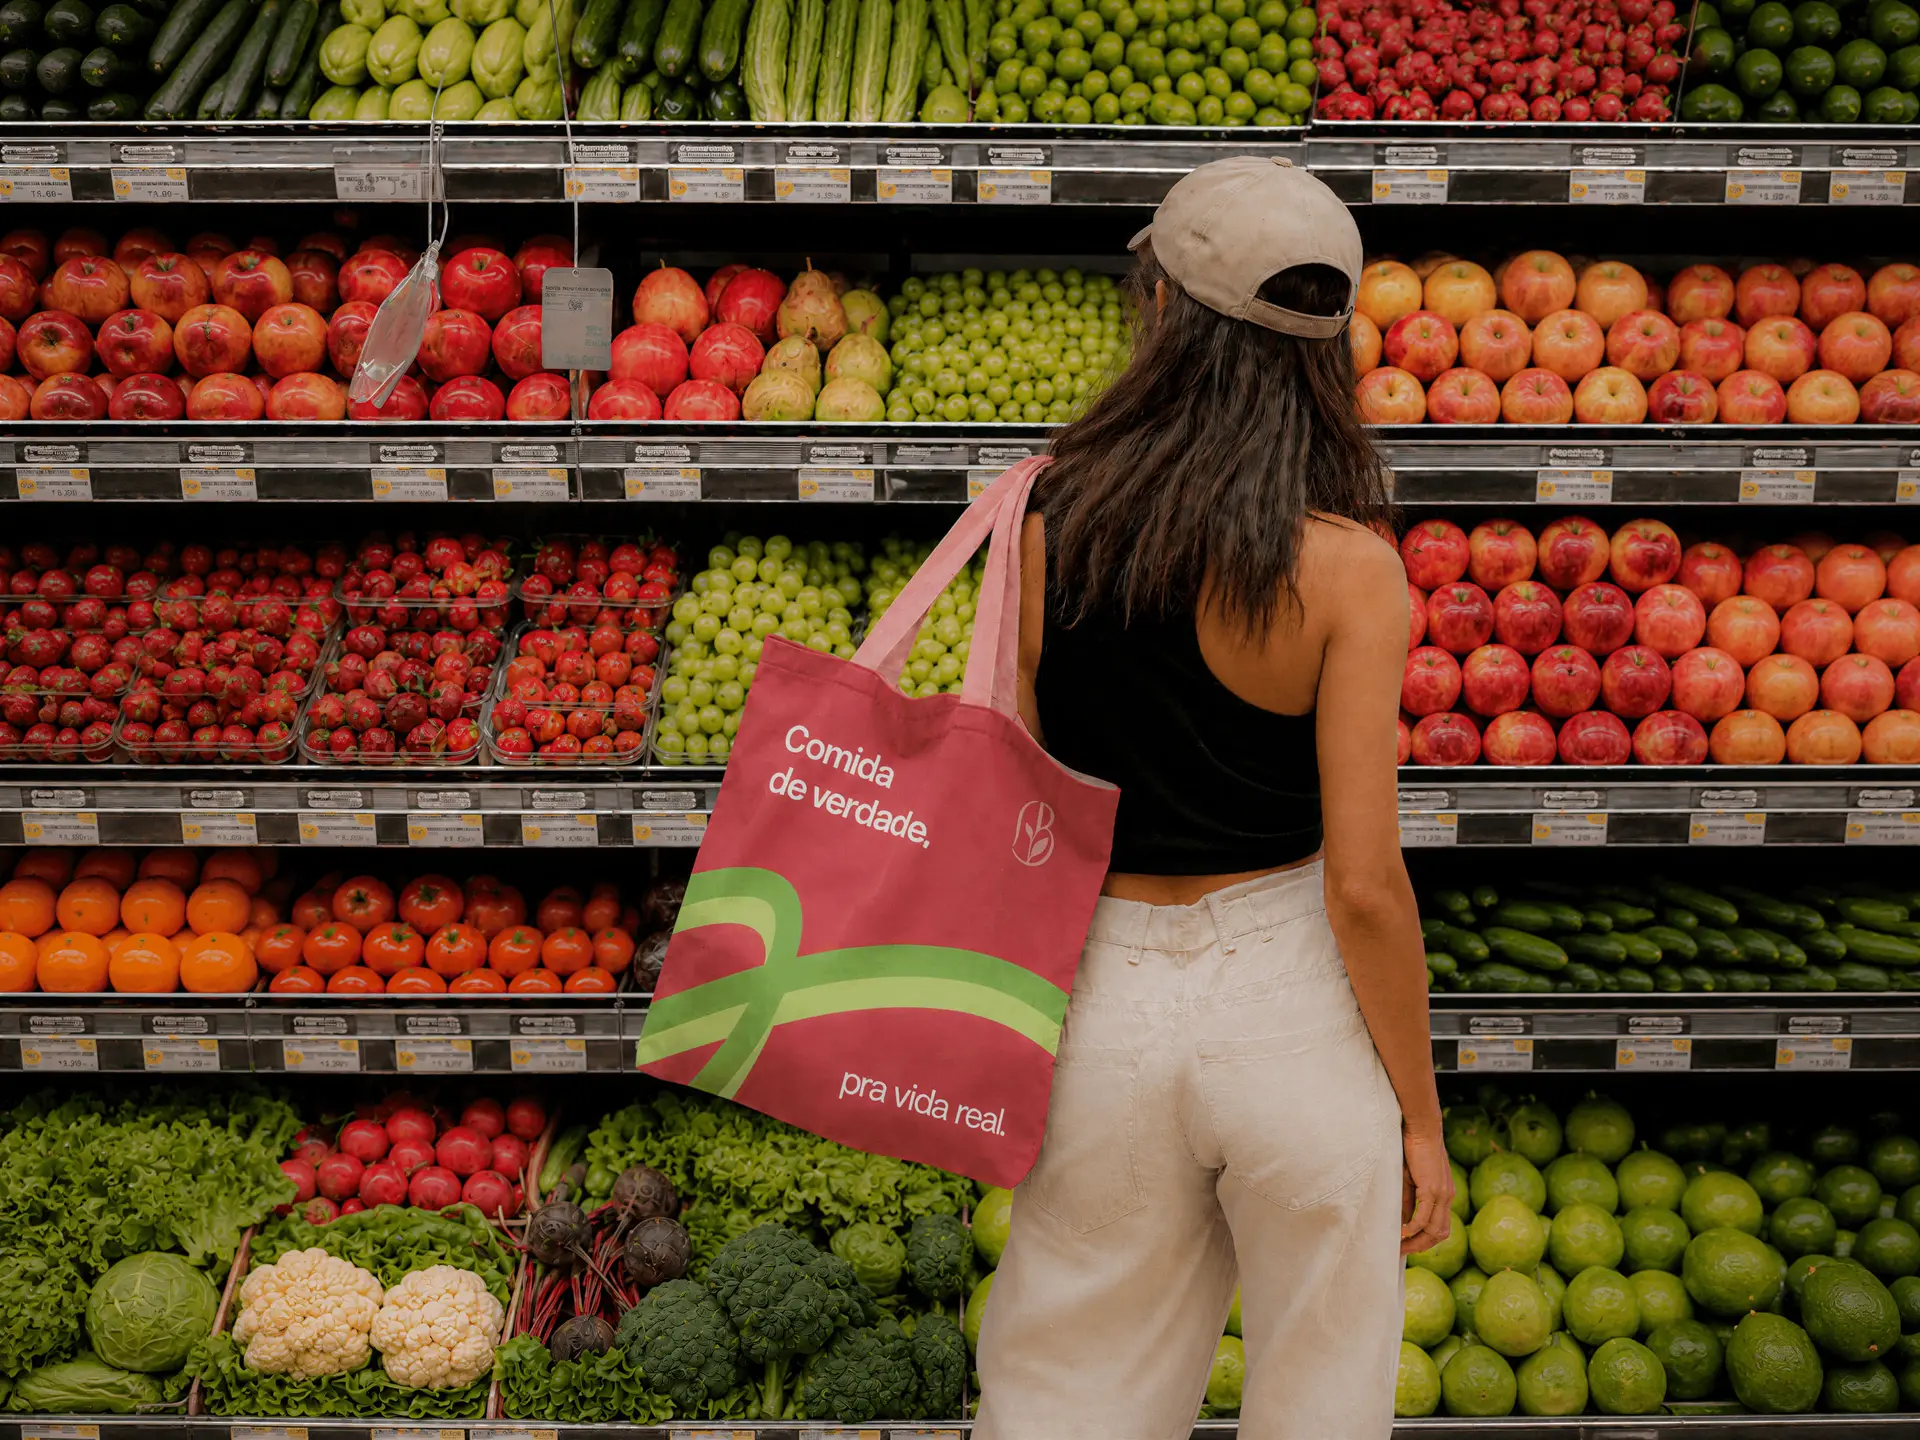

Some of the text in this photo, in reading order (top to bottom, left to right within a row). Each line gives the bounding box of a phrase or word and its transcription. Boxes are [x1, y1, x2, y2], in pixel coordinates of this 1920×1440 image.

[785, 725, 895, 789] Comida
[769, 767, 930, 848] de verdade,
[839, 1071, 1006, 1137] pra vida real.
